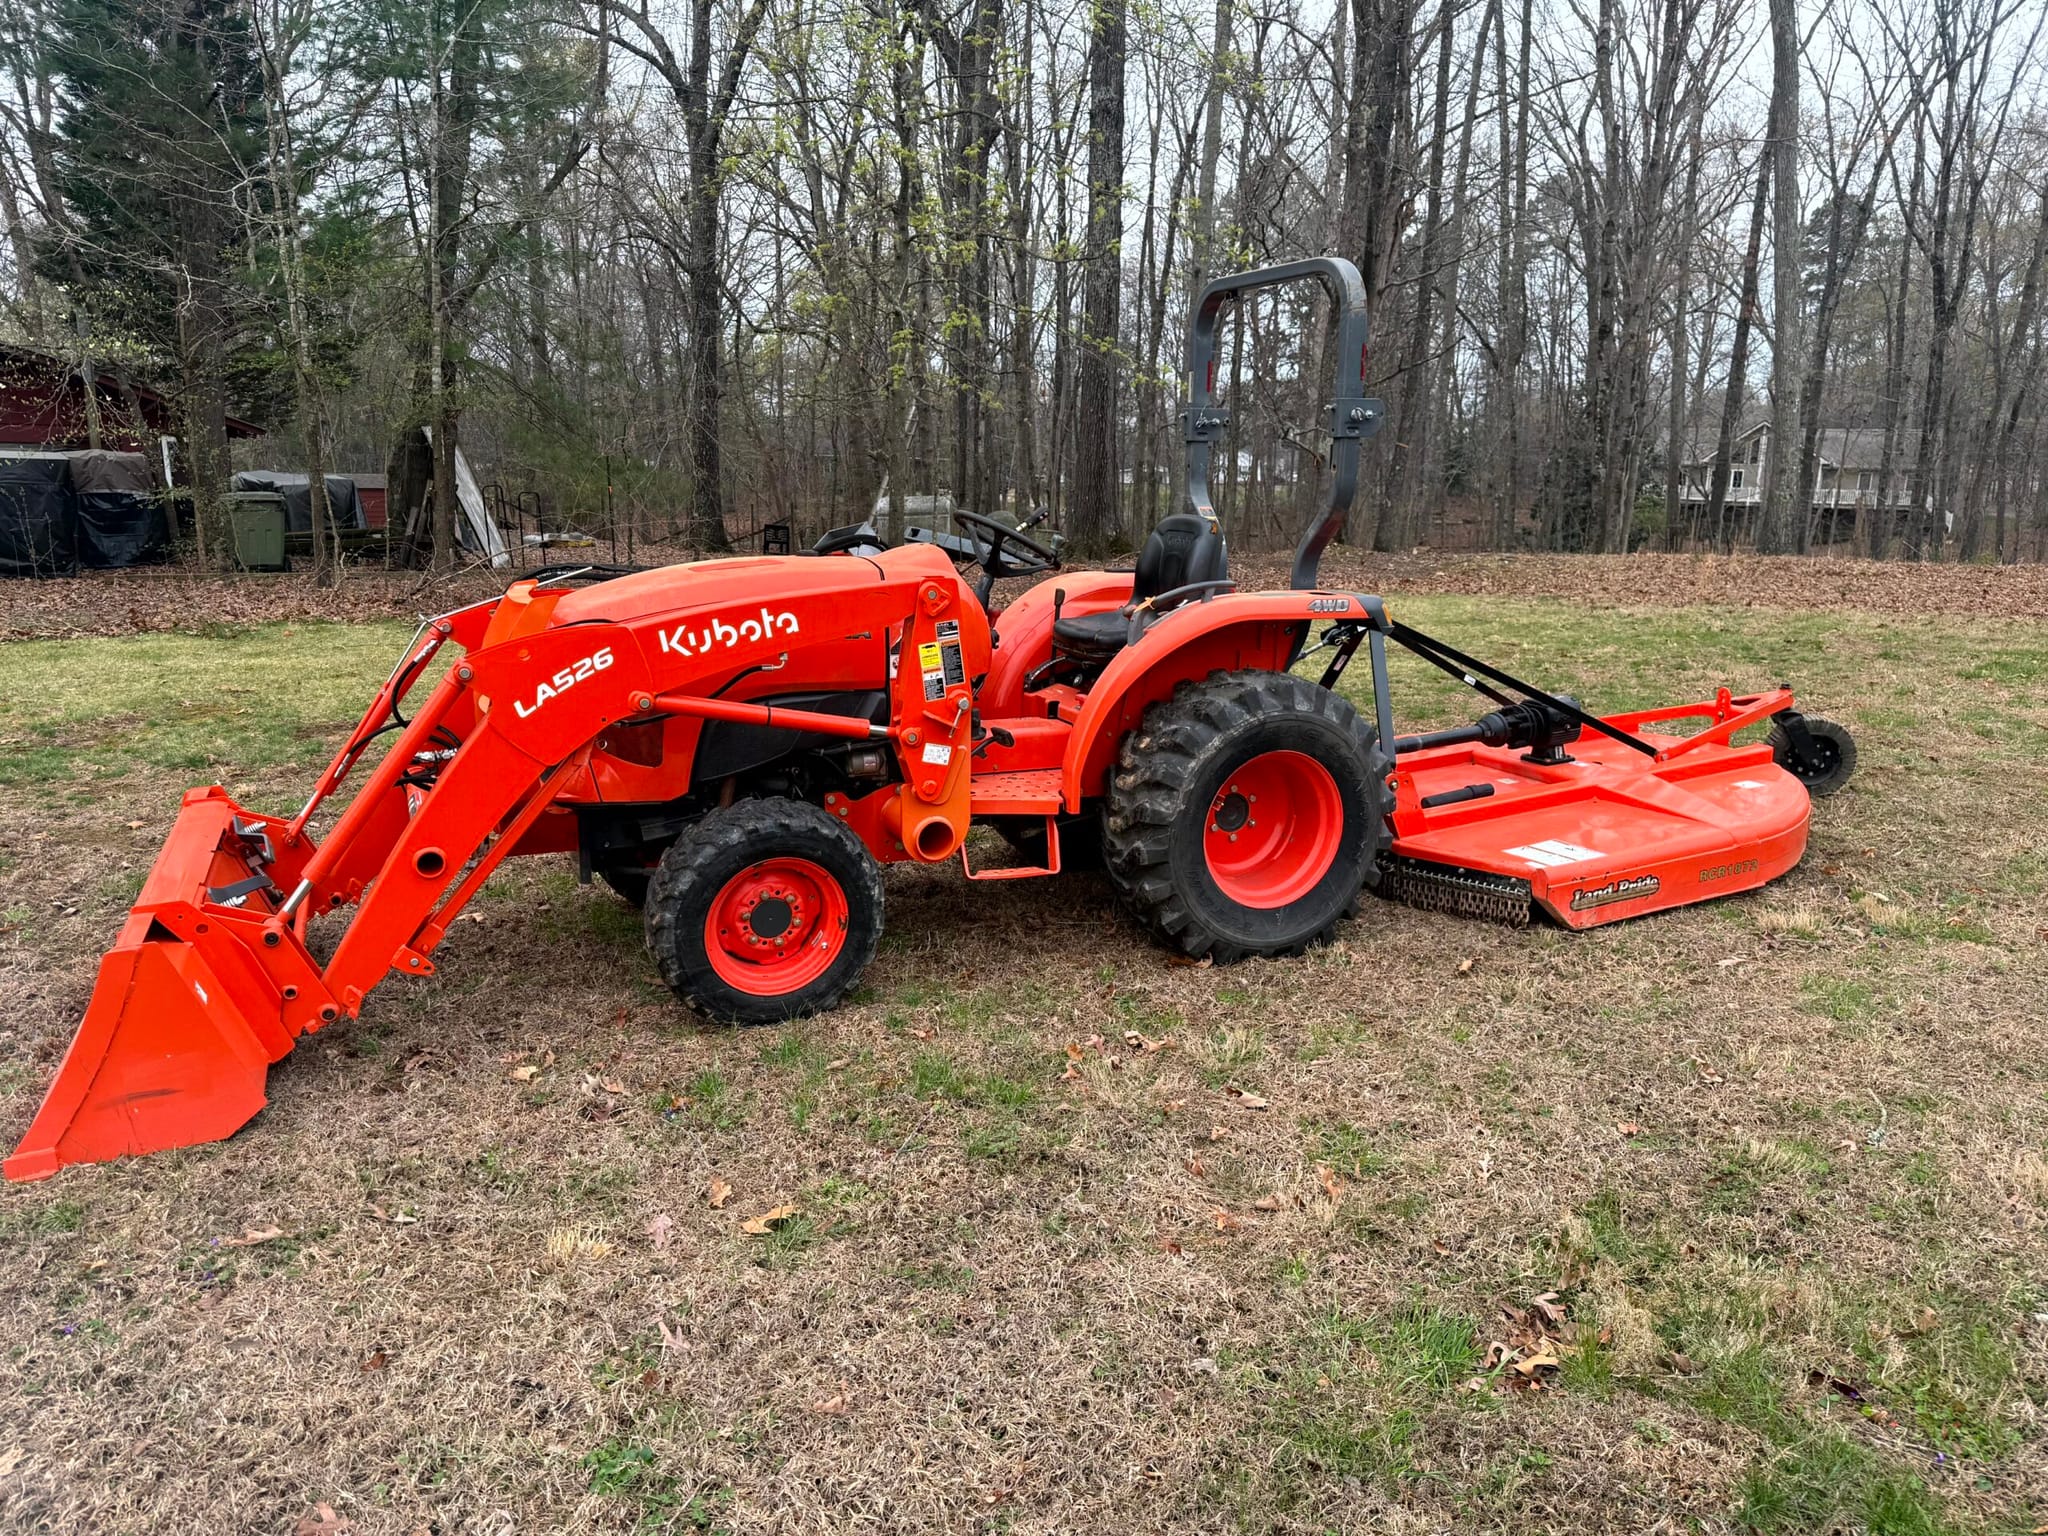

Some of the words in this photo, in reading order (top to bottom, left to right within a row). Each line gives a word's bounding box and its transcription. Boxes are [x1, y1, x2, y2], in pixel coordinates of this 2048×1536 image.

[1308, 599, 1350, 613] 4WD
[657, 607, 800, 657] Kubota
[513, 646, 614, 718] LA526
[1571, 883, 1614, 907] Land
[1618, 875, 1659, 896] Pride
